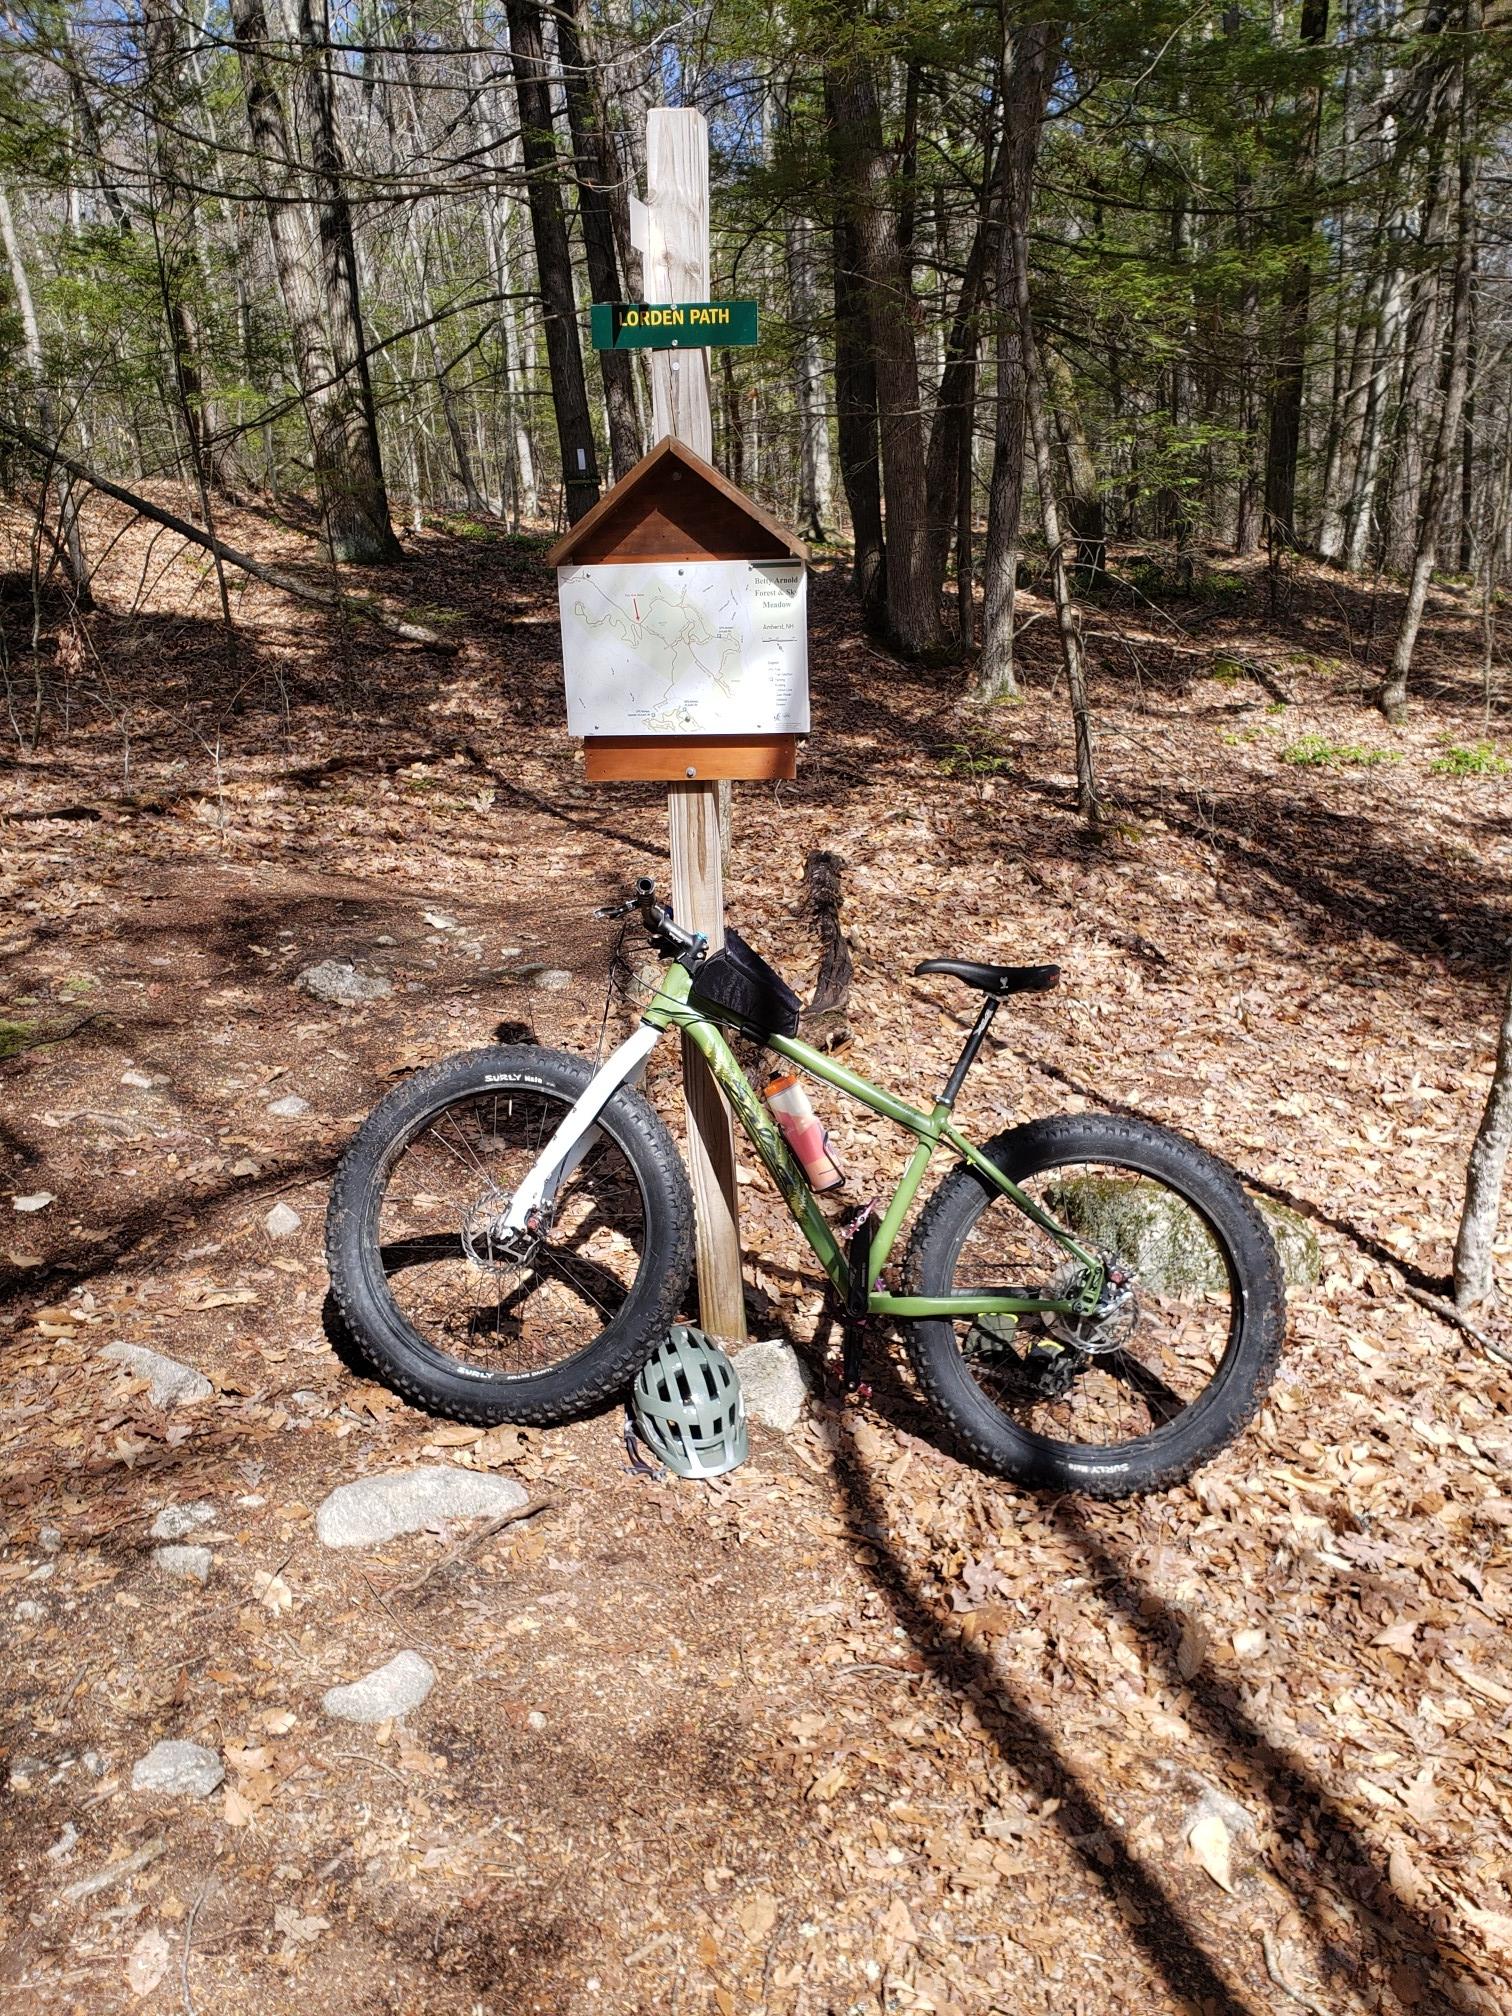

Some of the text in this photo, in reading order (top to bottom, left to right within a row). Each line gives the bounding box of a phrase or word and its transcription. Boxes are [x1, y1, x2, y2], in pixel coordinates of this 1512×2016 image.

[619, 308, 730, 327] LORDEN PATH
[755, 576, 798, 586] Betty Arnold
[755, 589, 776, 597] Forest
[484, 1073, 522, 1083] SURLY
[457, 1367, 494, 1378] SURLY
[1090, 1463, 1130, 1474] SURLY
